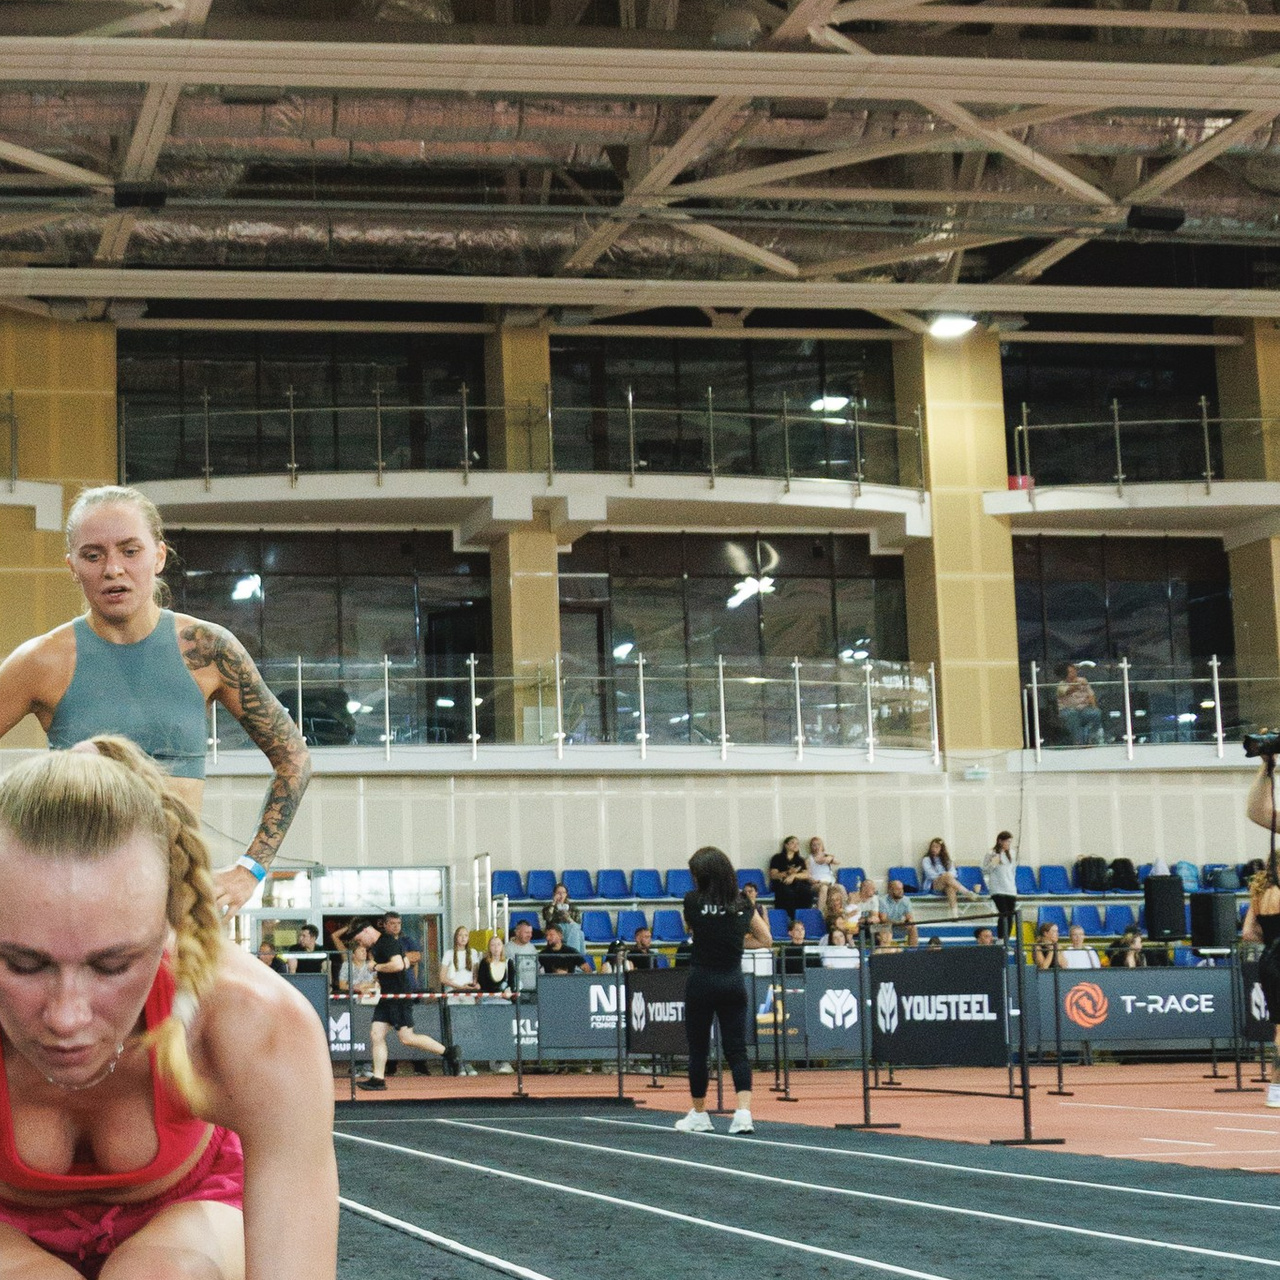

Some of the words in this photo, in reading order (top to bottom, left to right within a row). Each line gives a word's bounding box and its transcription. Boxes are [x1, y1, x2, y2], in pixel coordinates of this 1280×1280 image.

[647, 1001, 685, 1022] YOUST
[901, 994, 997, 1021] YOUSTEEL
[1120, 994, 1215, 1014] T-RACE
